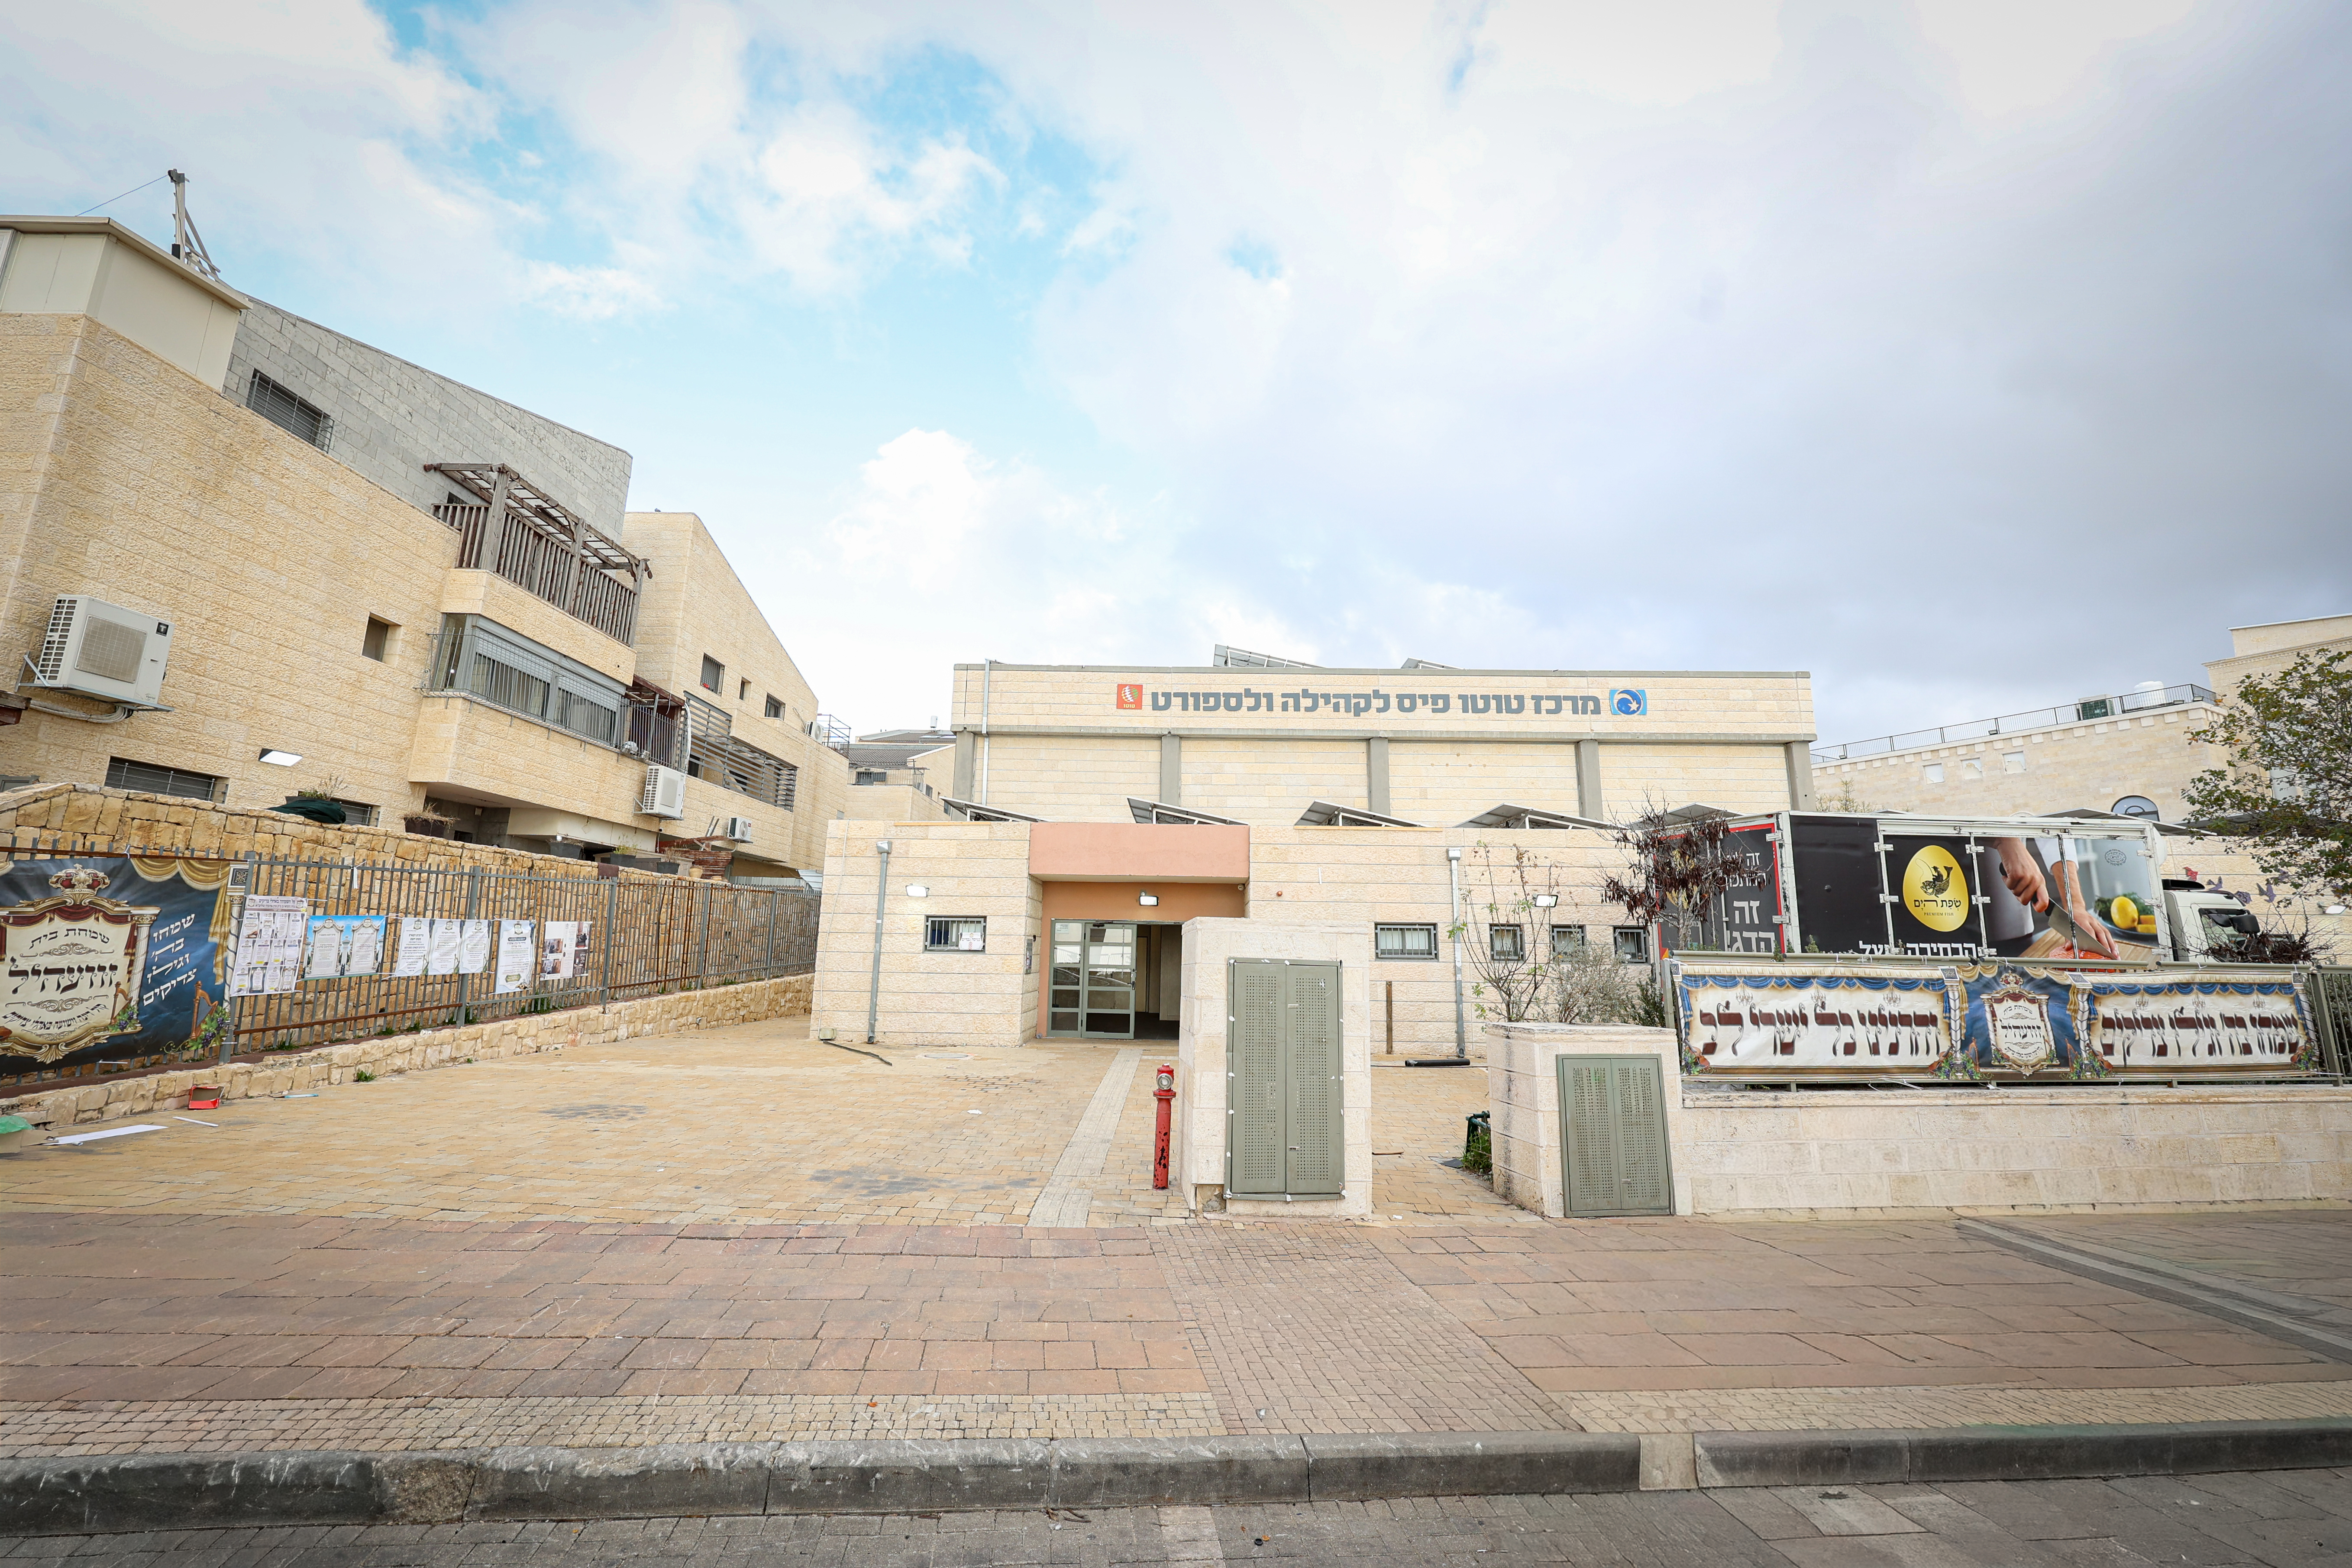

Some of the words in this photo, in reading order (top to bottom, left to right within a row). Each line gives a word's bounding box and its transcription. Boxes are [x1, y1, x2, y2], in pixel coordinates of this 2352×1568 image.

[1151, 688, 1273, 711] ולספורט
[1281, 689, 1390, 717] לקהילה
[1396, 693, 1450, 713] פיס
[1458, 694, 1525, 714] טוטו
[1531, 695, 1601, 714] מרכז
[1746, 852, 1760, 866] זה
[1733, 900, 1760, 924] זה
[64, 928, 110, 944] שמחת
[153, 914, 195, 943] שמחו
[29, 931, 58, 950] בית
[1906, 943, 1977, 957] הבחירה
[146, 953, 190, 984] וגילו
[143, 968, 197, 1007] צדיקים
[77, 1011, 94, 1022] רנה
[85, 1003, 109, 1012] קול
[2003, 1006, 2013, 1015] בית
[2014, 1005, 2033, 1014] שמחת
[1, 1011, 32, 1027] צדיקים
[30, 1016, 53, 1030] באהלי
[53, 1017, 77, 1030] וישועה
[1699, 1000, 1743, 1056] לב
[1749, 1002, 1809, 1056] ישרי
[1814, 1000, 1857, 1056] כל
[1857, 1003, 1941, 1056] והרנינו
[2100, 1008, 2168, 1068] צדיקים
[2168, 1005, 2223, 1057] וגילו
[2249, 1012, 2300, 1055] שמחו
